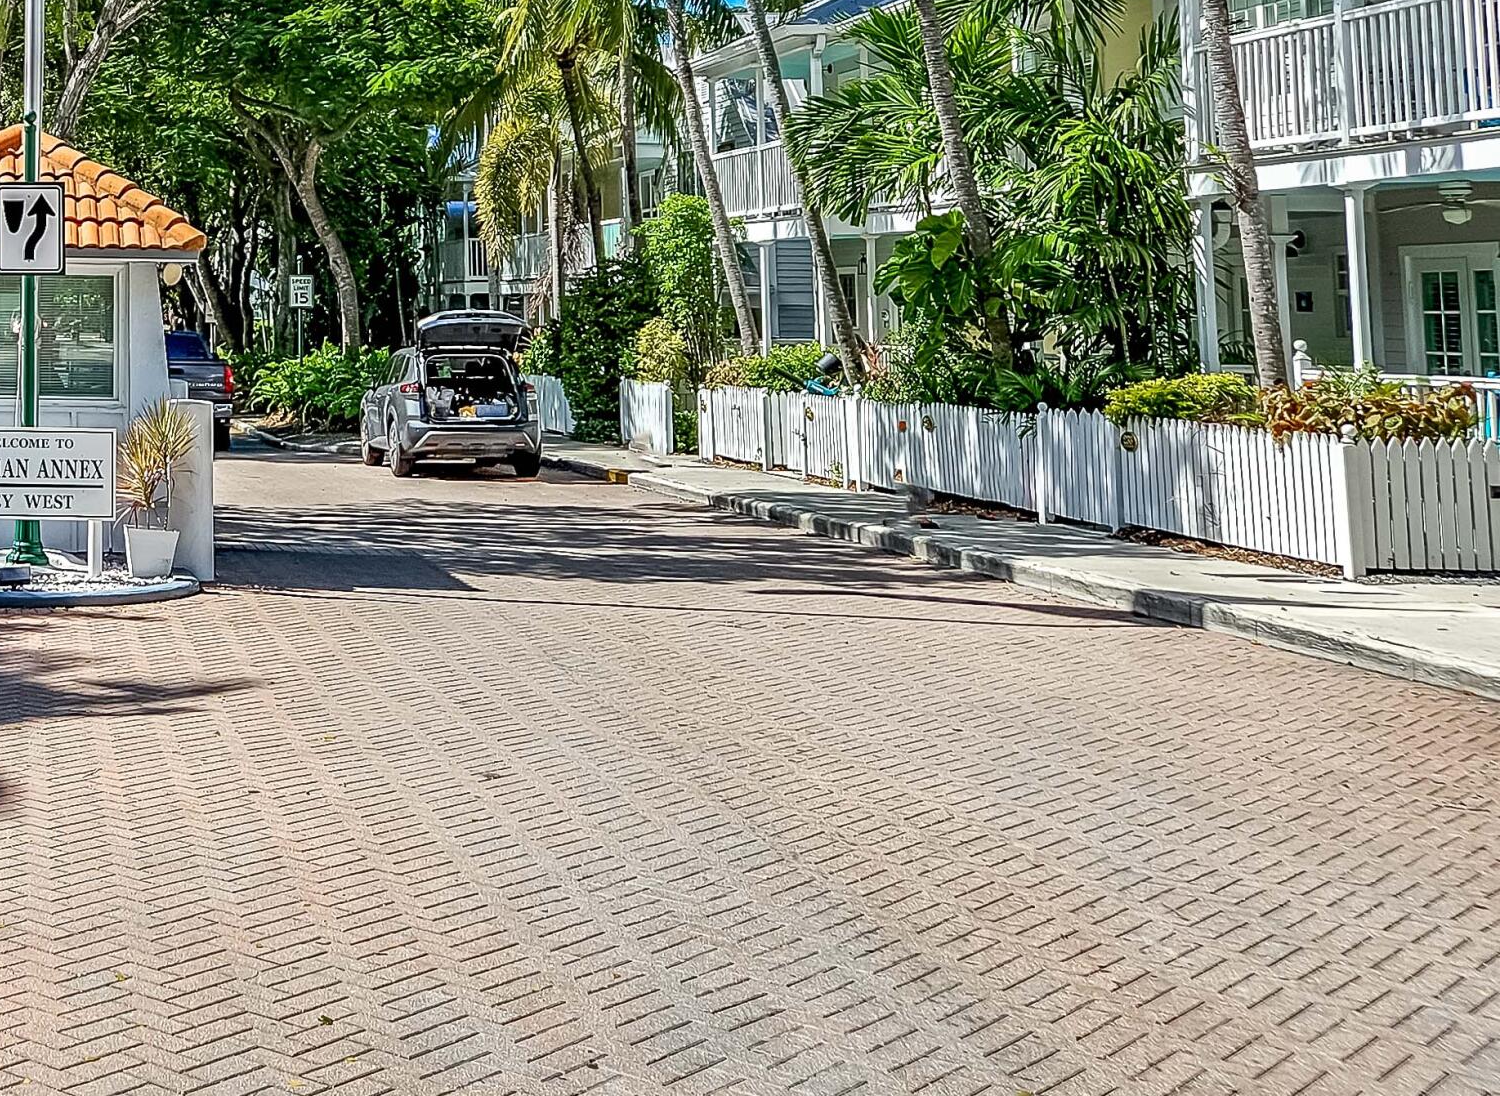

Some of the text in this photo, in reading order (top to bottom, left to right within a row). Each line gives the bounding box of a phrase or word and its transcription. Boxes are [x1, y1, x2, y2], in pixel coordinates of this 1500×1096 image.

[294, 292, 308, 304] 15
[55, 438, 74, 449] TO
[36, 458, 104, 480] ANNEX
[24, 494, 74, 510] WEST
